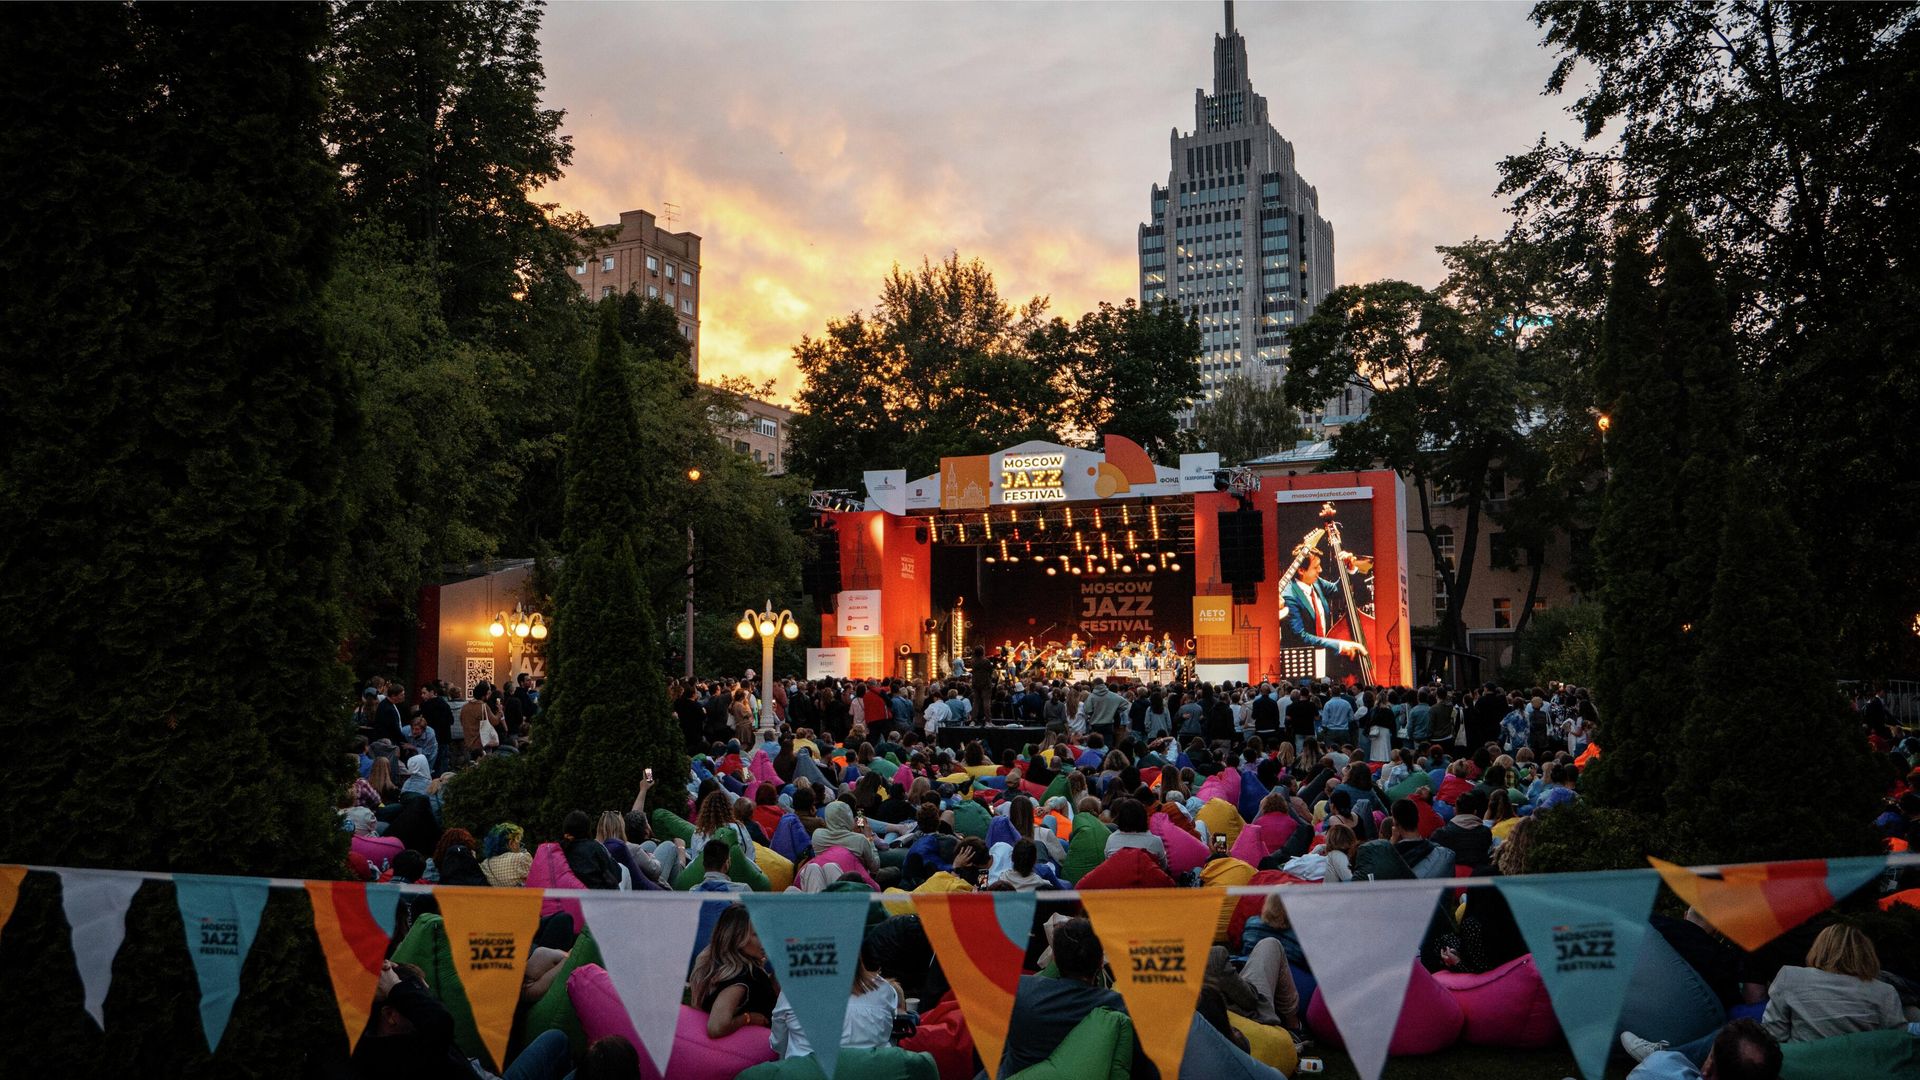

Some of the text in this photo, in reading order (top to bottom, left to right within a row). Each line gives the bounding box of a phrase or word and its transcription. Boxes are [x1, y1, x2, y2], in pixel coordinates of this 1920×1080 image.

[1004, 456, 1063, 468] MOSCOW
[1001, 469, 1064, 489] JAZZ
[1160, 476, 1179, 484] ФОНД
[1004, 489, 1064, 501] FESTIVAL
[1291, 490, 1357, 499] moscowjazzfest.com
[1081, 581, 1153, 595] MOSCOW
[1082, 595, 1154, 617] JAZZ
[1199, 609, 1226, 617] ЛЕТО
[1081, 619, 1154, 632] FESTIVAL
[201, 932, 239, 945] JAZZ
[1552, 929, 1614, 941] MOSCOW
[469, 938, 514, 946] MOSCOW
[786, 943, 835, 952] MOSCOW
[200, 947, 239, 956] FESTIVAL
[470, 947, 516, 961] JAZZ
[1129, 945, 1184, 954] MOSCOW
[1555, 940, 1616, 961] JAZZ
[789, 952, 838, 967] JAZZ
[1131, 955, 1186, 971] JAZZ
[471, 962, 513, 970] FESTIVAL
[789, 967, 838, 977] FESTIVAL
[1556, 960, 1616, 973] FESTIVAL
[1132, 975, 1185, 983] FESTIVAL
